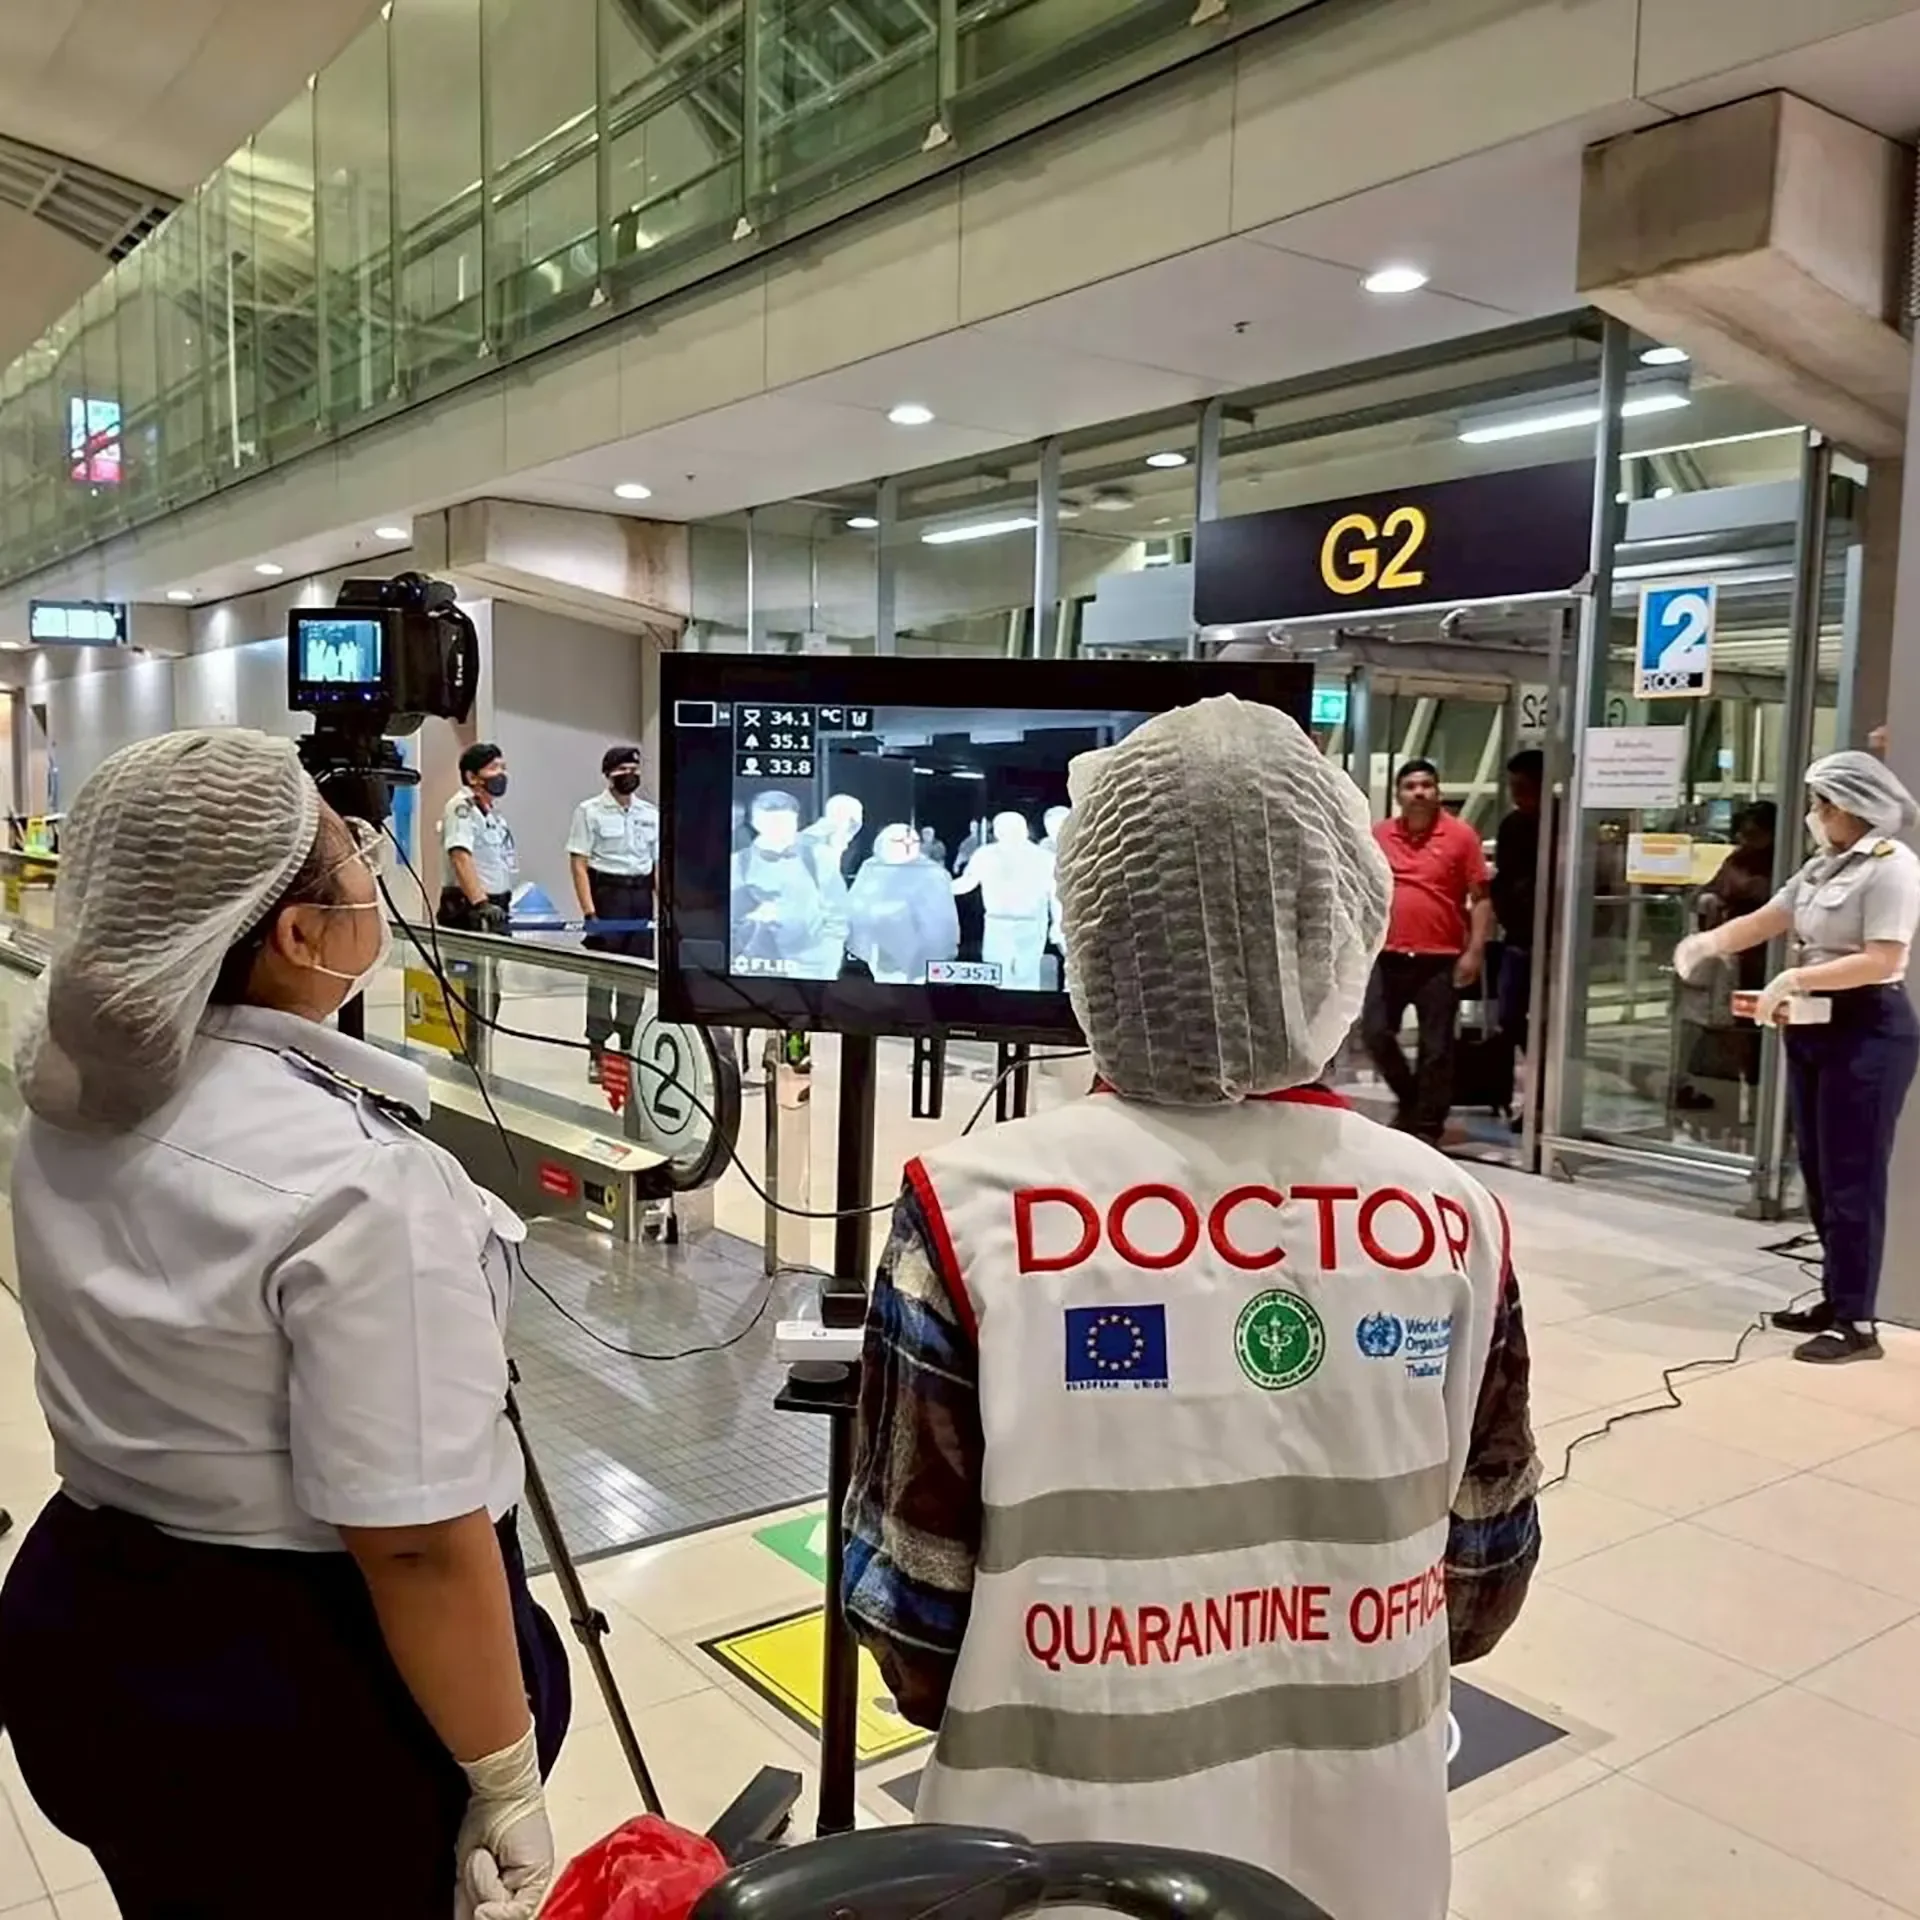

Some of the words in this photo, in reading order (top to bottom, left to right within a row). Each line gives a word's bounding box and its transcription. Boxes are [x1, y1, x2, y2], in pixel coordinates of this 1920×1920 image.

[1320, 506, 1427, 595] G2
[1658, 593, 1709, 673] 2
[769, 710, 811, 726] 34.1
[769, 733, 811, 749] 35.1
[769, 759, 812, 774] 33.8
[962, 967, 998, 981] 35.1
[653, 1032, 681, 1120] 2
[1013, 1183, 1470, 1274] DOCTOR
[1025, 1586, 1330, 1671] QUARANTINE
